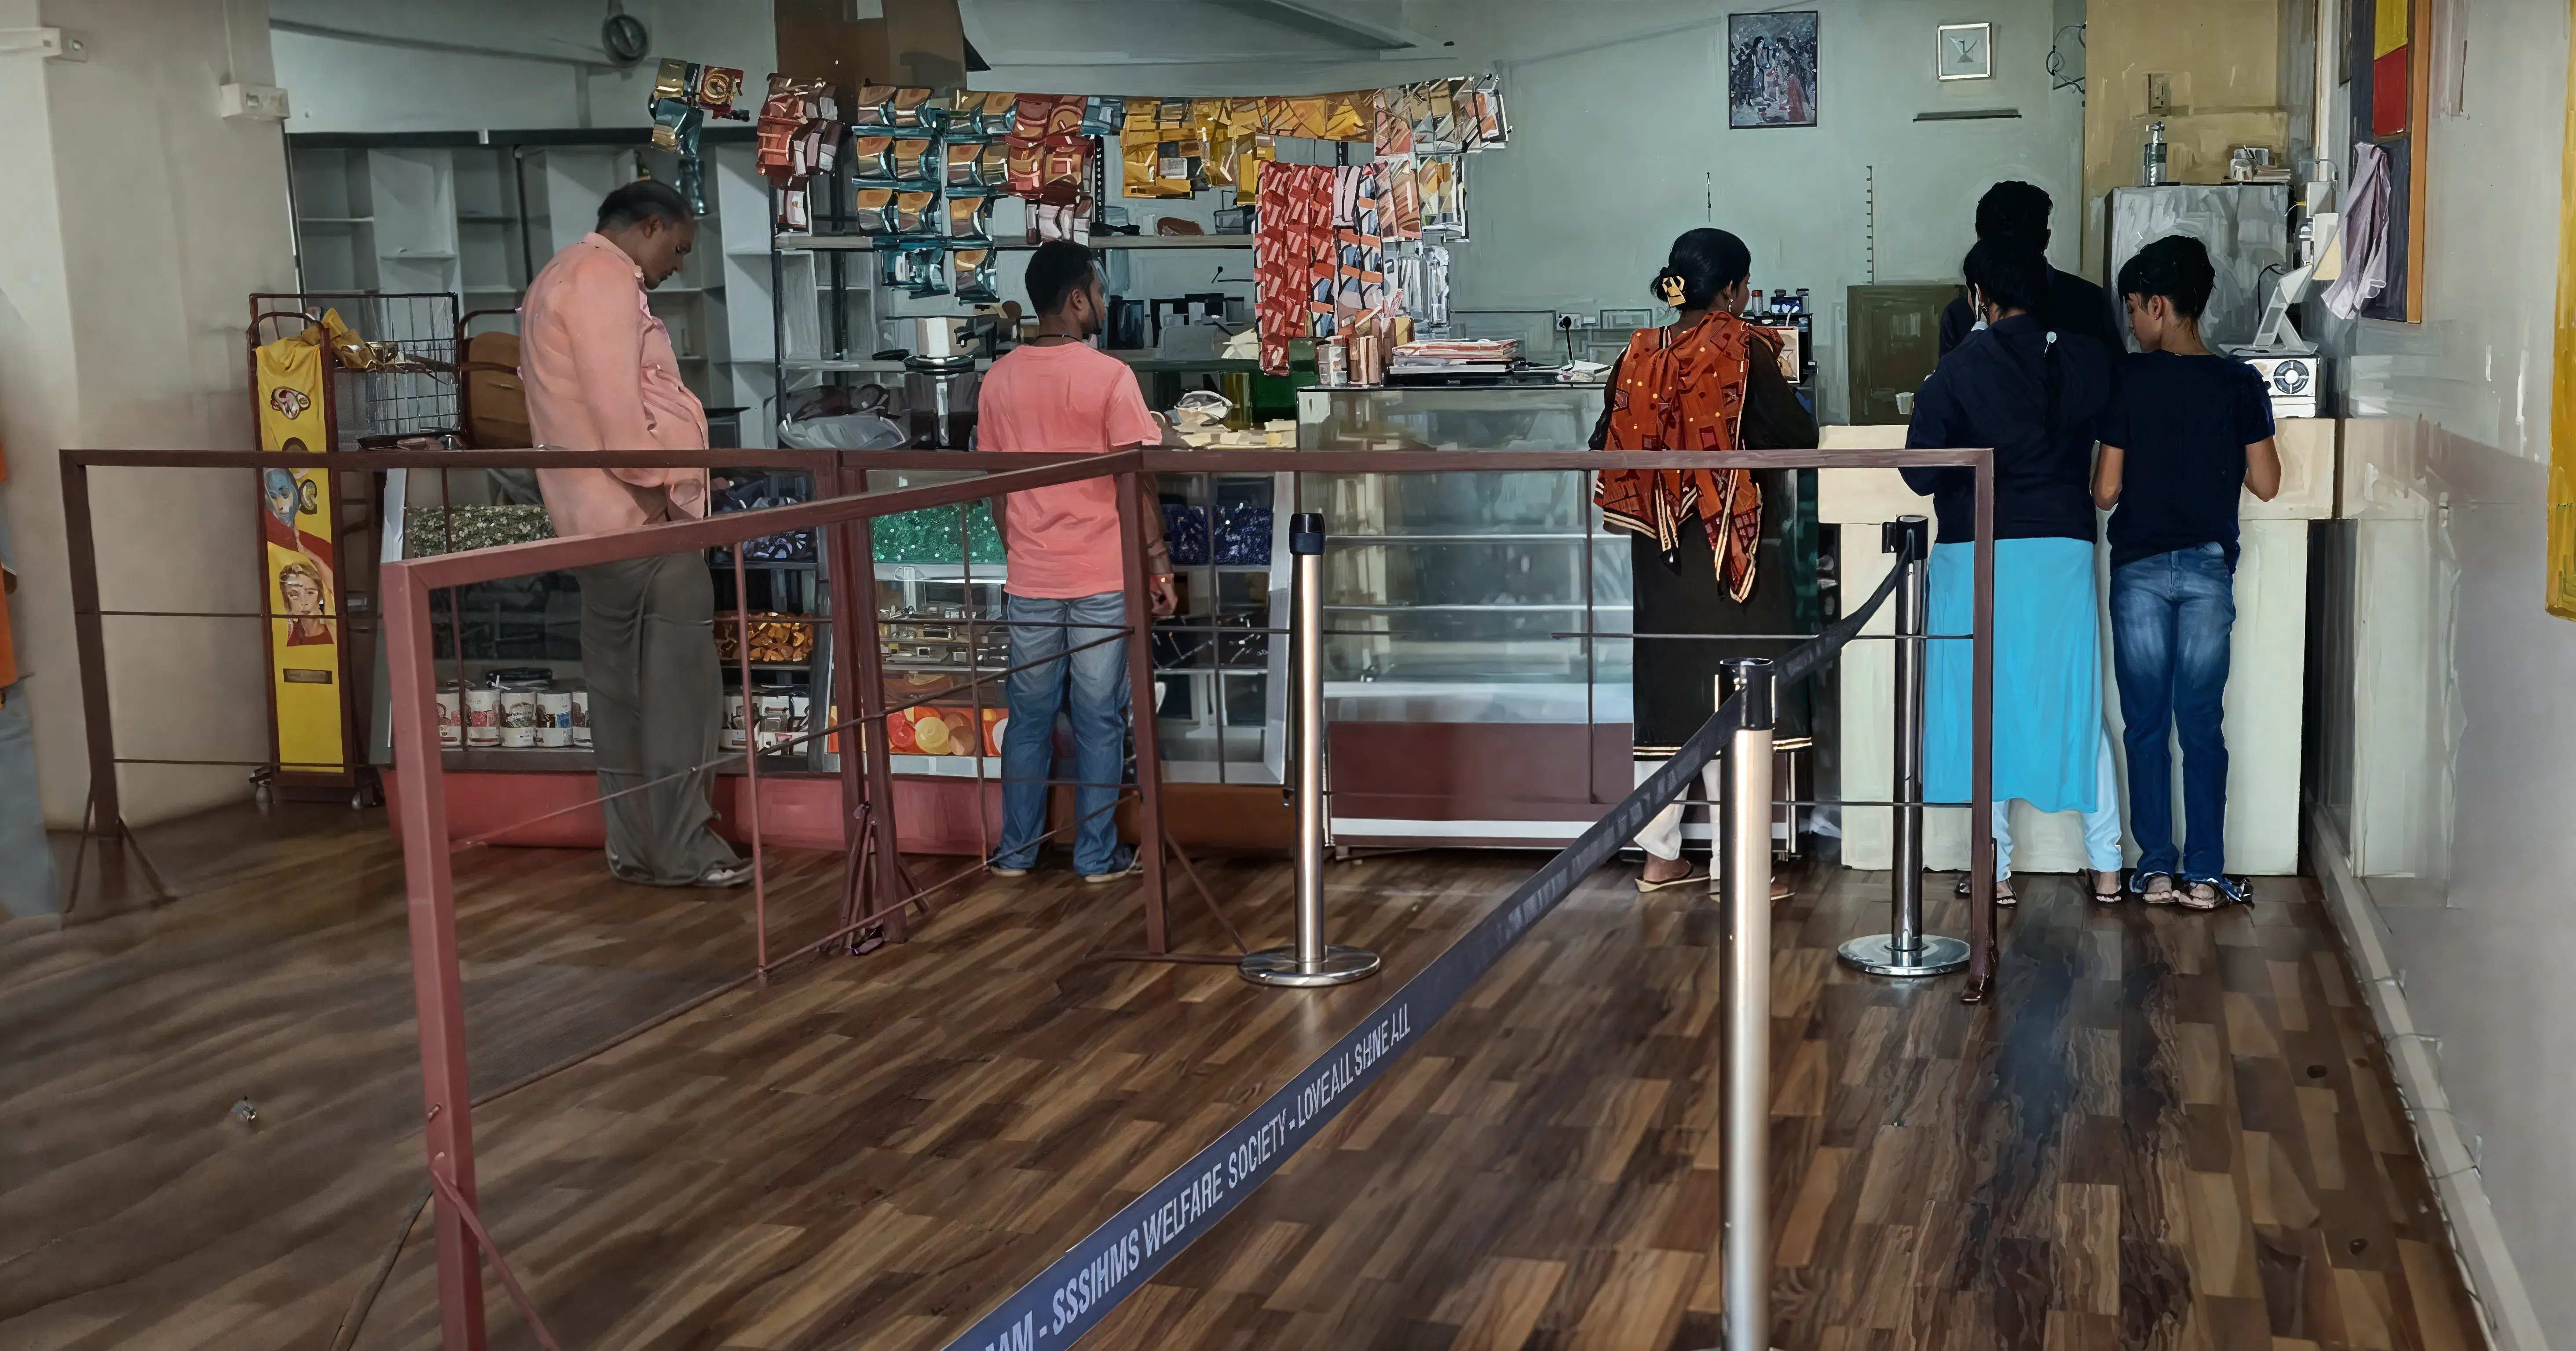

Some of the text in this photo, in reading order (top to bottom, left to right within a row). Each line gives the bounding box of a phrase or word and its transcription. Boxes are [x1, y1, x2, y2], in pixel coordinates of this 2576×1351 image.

[1053, 1228, 1140, 1336] SSSIHMS
[1143, 1162, 1223, 1258] WELFARE
[1229, 1108, 1286, 1188] SOCIETY
[1391, 1003, 1411, 1047] ALL
